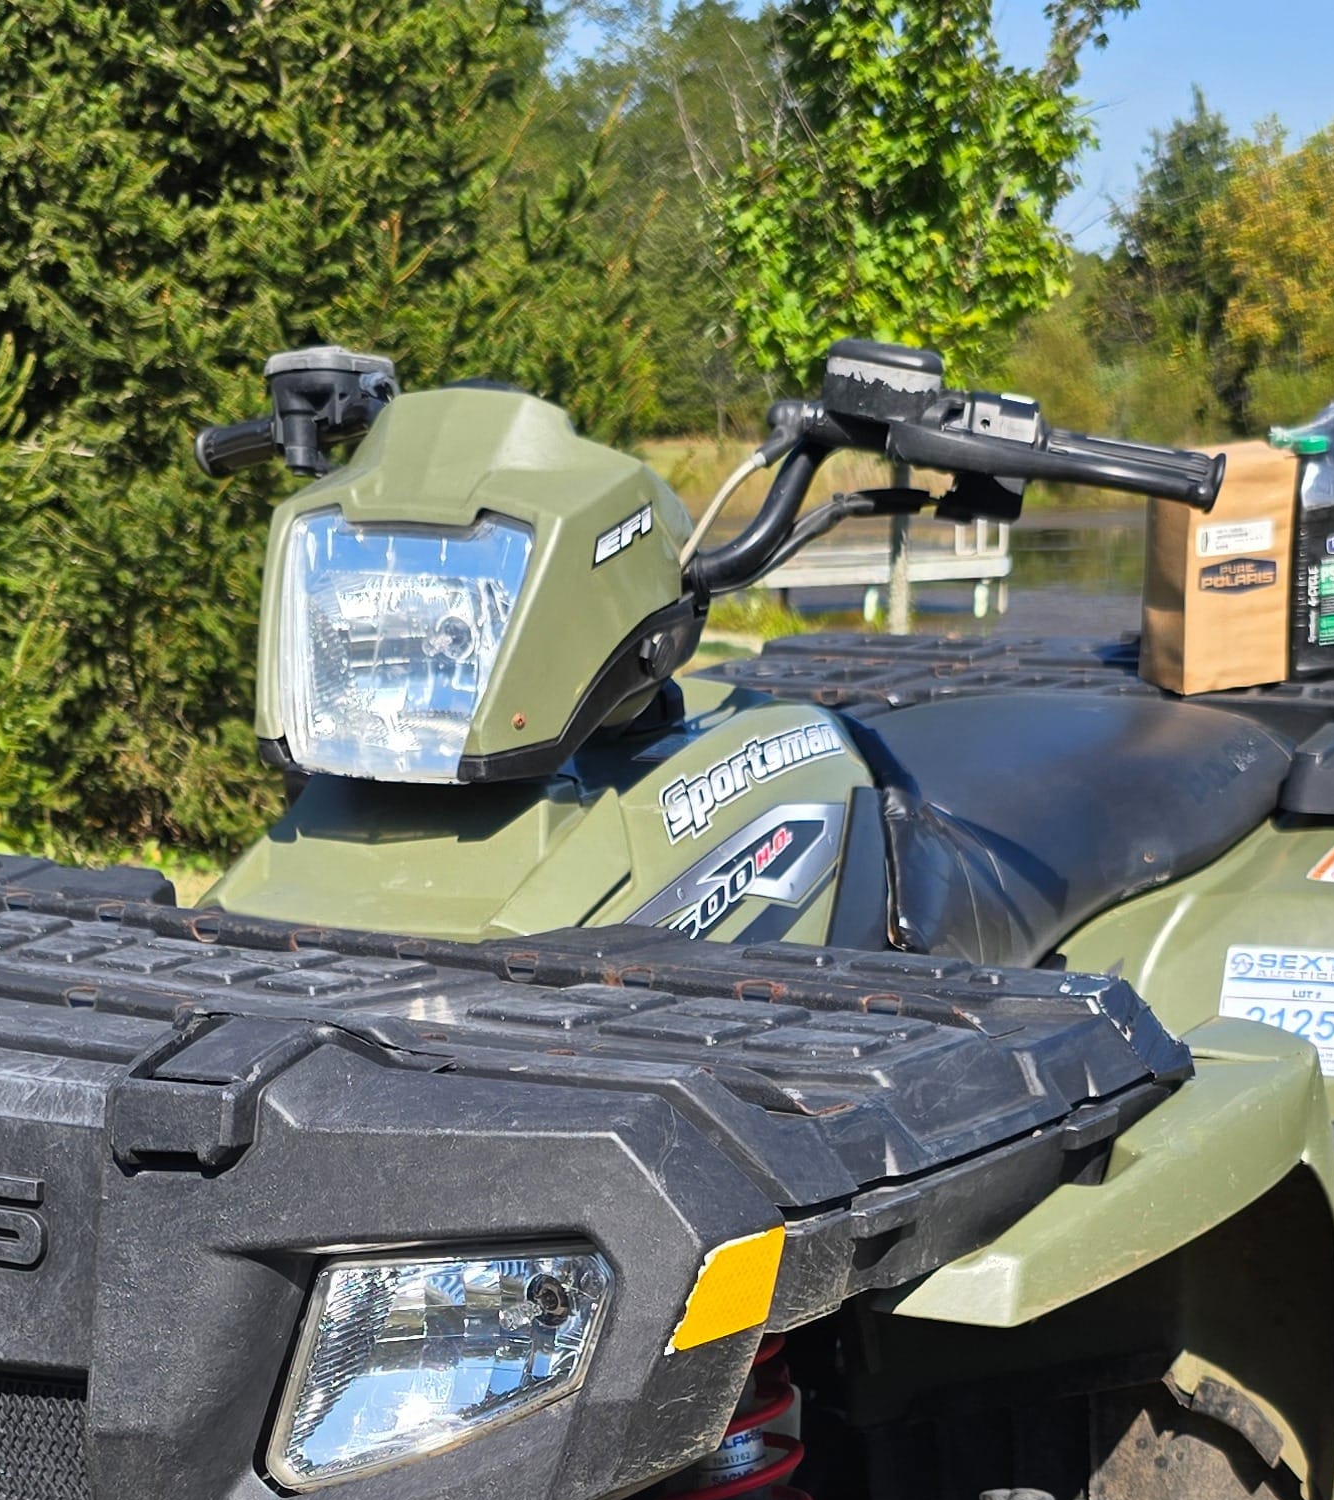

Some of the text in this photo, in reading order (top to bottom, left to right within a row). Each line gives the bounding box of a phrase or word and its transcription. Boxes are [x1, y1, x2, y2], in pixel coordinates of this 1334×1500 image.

[593, 503, 652, 566] EFI
[1220, 563, 1257, 576] PURE
[1201, 572, 1275, 590] POLARIS
[660, 723, 844, 844] Sportsman
[1292, 989, 1312, 999] LOT
